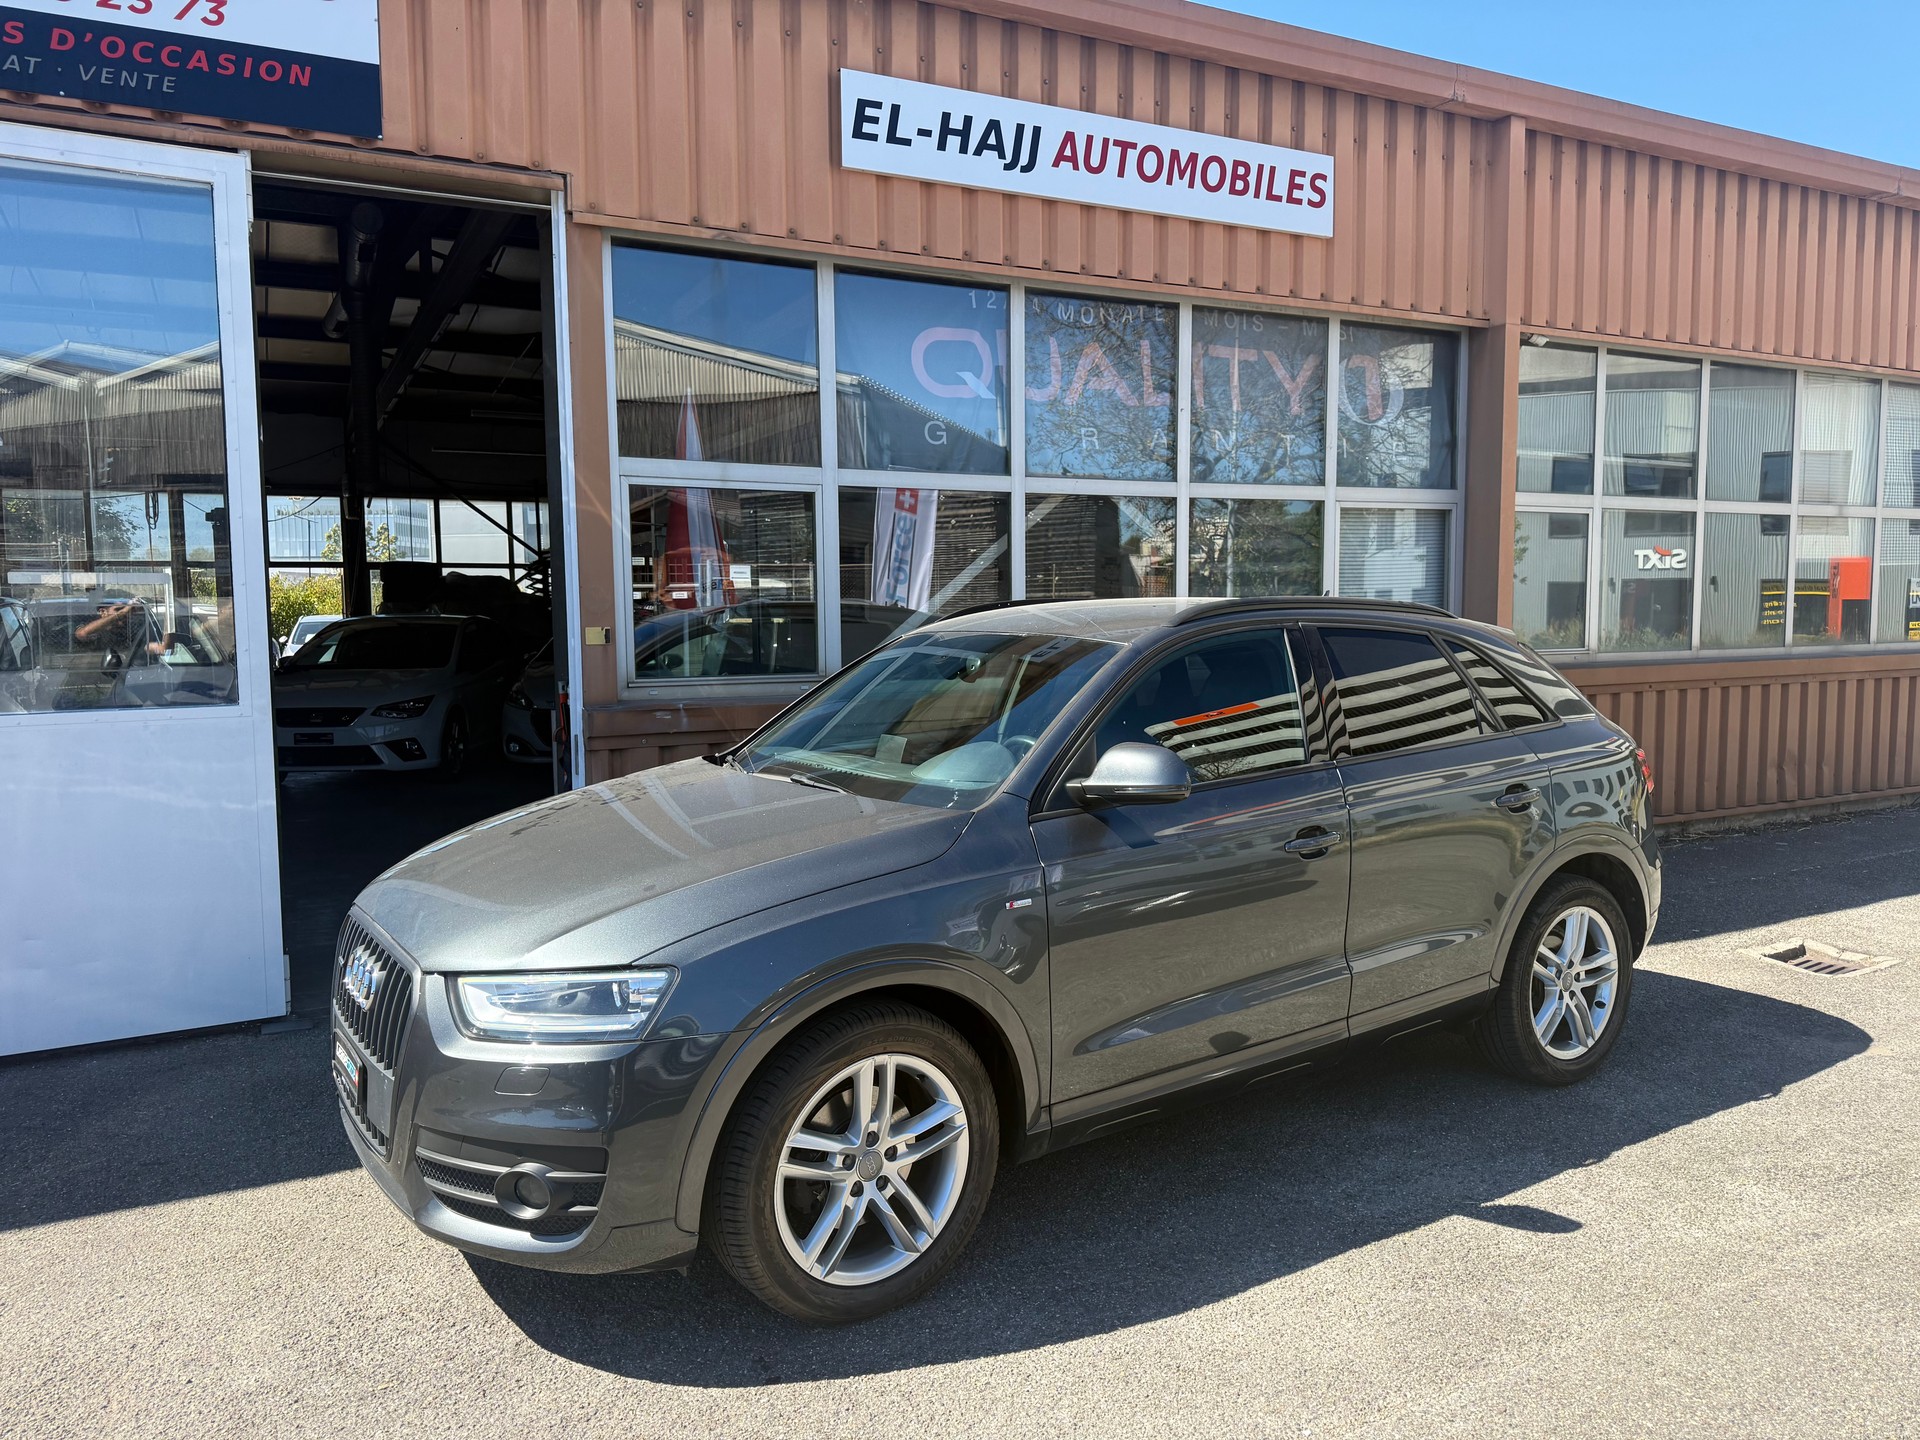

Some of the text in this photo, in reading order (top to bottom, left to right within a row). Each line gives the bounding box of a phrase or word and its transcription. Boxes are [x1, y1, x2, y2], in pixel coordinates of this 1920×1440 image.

[49, 27, 312, 87] D’OCCASION
[78, 63, 177, 93] VENTE
[851, 97, 1328, 210] EL-HAJJ AUTOMOBILES
[1056, 302, 1166, 325] MONATE
[1203, 308, 1265, 332] MOIS
[1302, 319, 1355, 343] MSI
[924, 420, 1408, 465] GRANTIE
